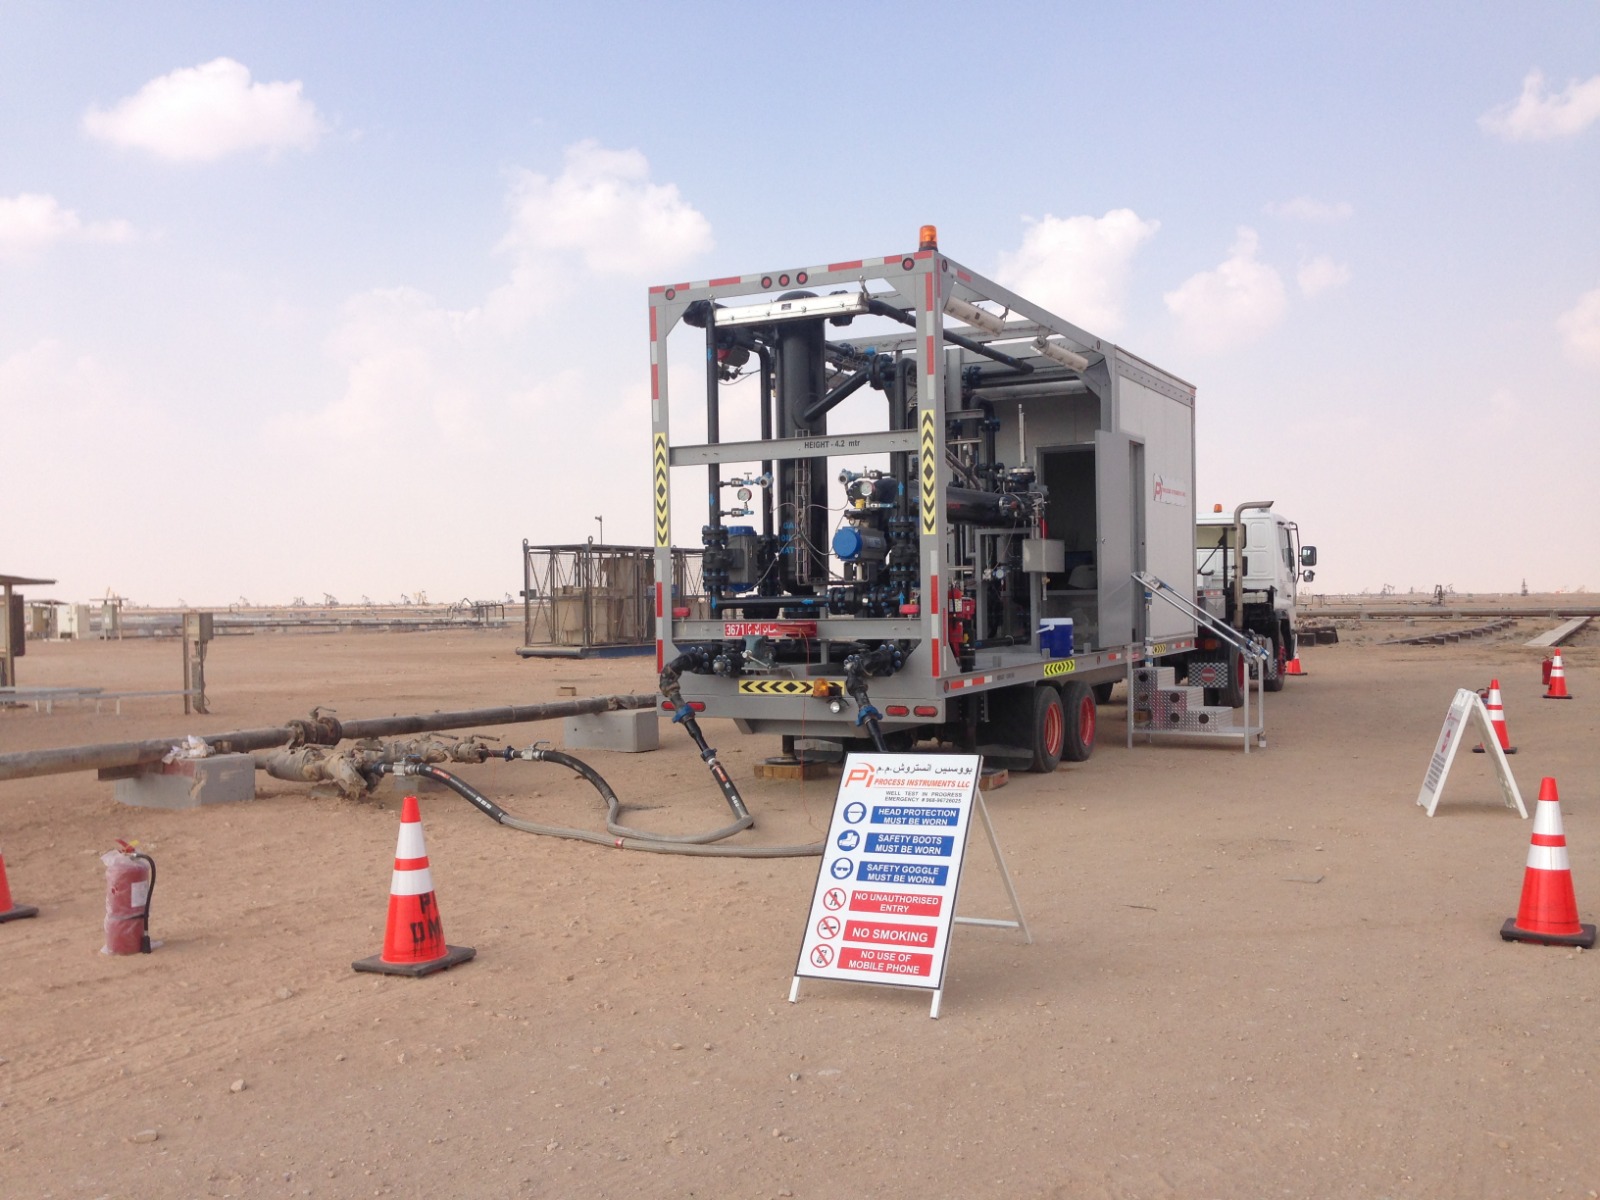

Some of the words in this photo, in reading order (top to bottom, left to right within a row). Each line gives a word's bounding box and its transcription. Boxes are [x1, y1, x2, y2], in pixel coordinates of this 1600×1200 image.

[726, 624, 744, 635] 3671
[903, 809, 956, 817] PROTECTION
[878, 835, 911, 843] SAFETY
[912, 836, 942, 844] BOOTS
[875, 845, 899, 853] MUST
[915, 847, 941, 855] WORN
[867, 864, 900, 872] SAFETY
[902, 866, 939, 875] GOGGLE
[908, 876, 935, 884] WORN
[870, 893, 938, 905] UNAUTHORISED
[880, 904, 909, 912] ENTRY
[852, 928, 869, 938] NO
[872, 929, 928, 942] SMOKING
[861, 951, 874, 959] NO
[877, 952, 896, 960] USE
[898, 954, 911, 962] OF
[849, 960, 884, 970] MOBILE
[886, 964, 919, 974] PHONE
